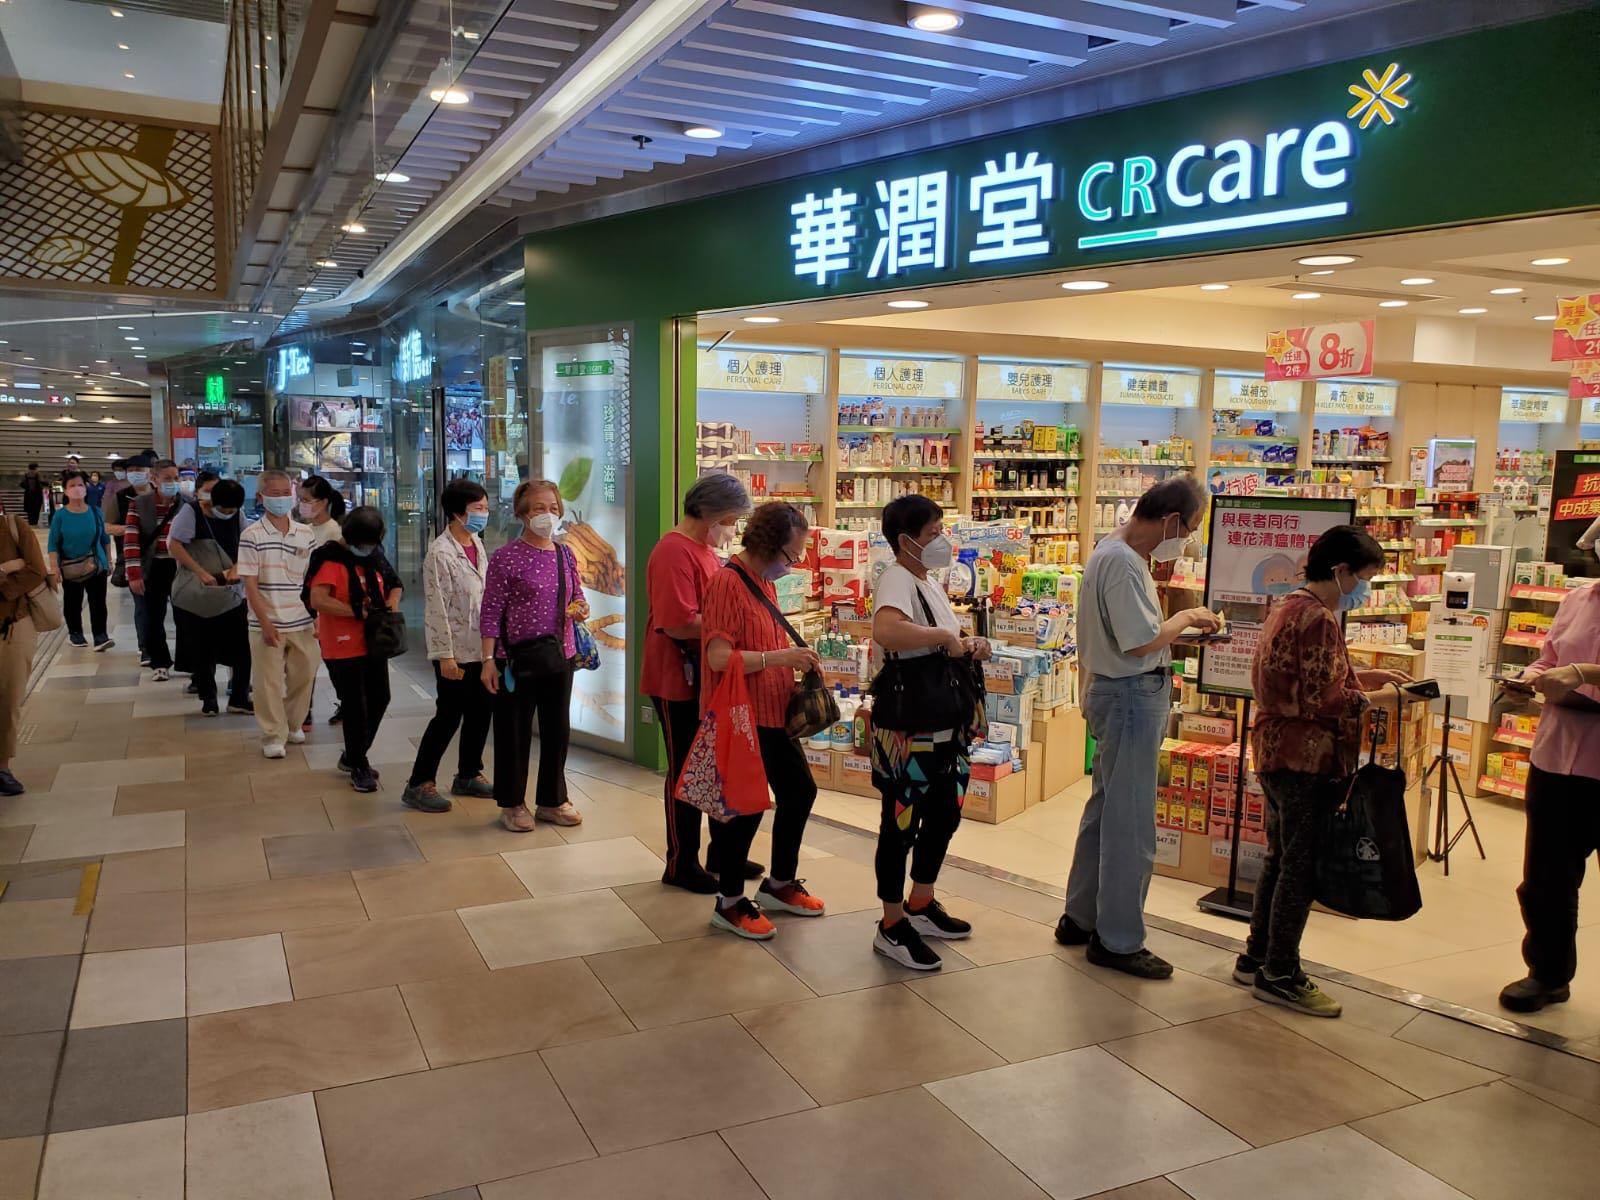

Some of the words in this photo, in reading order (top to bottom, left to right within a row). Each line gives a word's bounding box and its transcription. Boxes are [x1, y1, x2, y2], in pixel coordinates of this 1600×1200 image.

[790, 151, 1054, 285] 華潤堂
[1318, 332, 1355, 370] 8折
[727, 359, 782, 376] 個人護理
[874, 366, 924, 382] 個人護理
[1285, 366, 1301, 377] 2件
[726, 376, 761, 384] PERSONAL
[906, 383, 924, 391] CARE
[1583, 476, 1600, 492] 抗
[1222, 512, 1300, 530] 與長者同行
